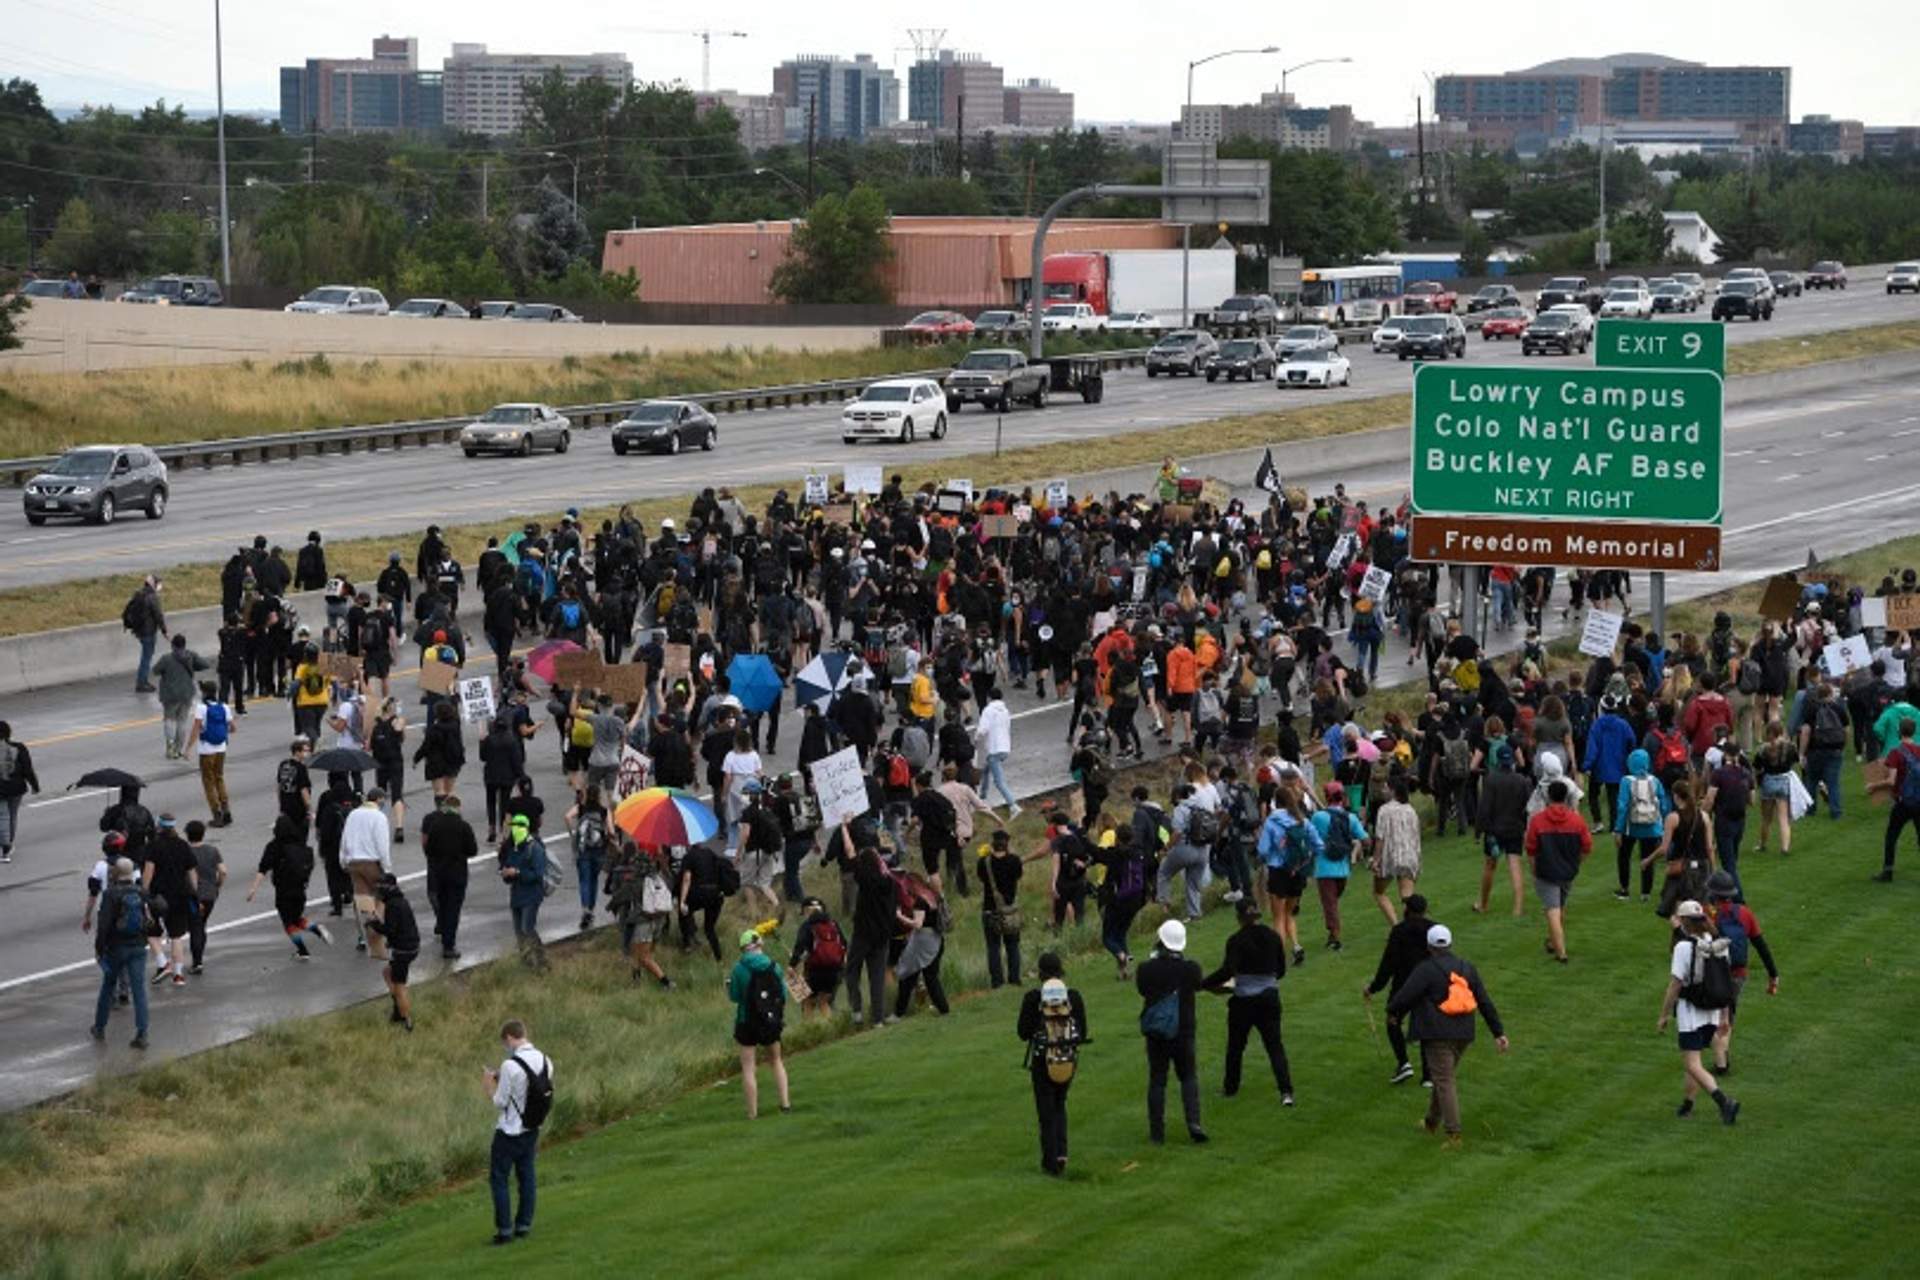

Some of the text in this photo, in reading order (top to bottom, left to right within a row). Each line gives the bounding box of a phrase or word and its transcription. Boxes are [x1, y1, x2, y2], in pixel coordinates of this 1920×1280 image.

[1617, 332, 1703, 359] EXIT 9
[1450, 379, 1686, 411] Lowry Campus
[1434, 412, 1700, 444] Colo Nat'l Guard
[1427, 447, 1706, 481] Buckley AF Base
[1495, 487, 1634, 509] NEXT RIGHT
[1445, 530, 1685, 558] Freedom Memorial
